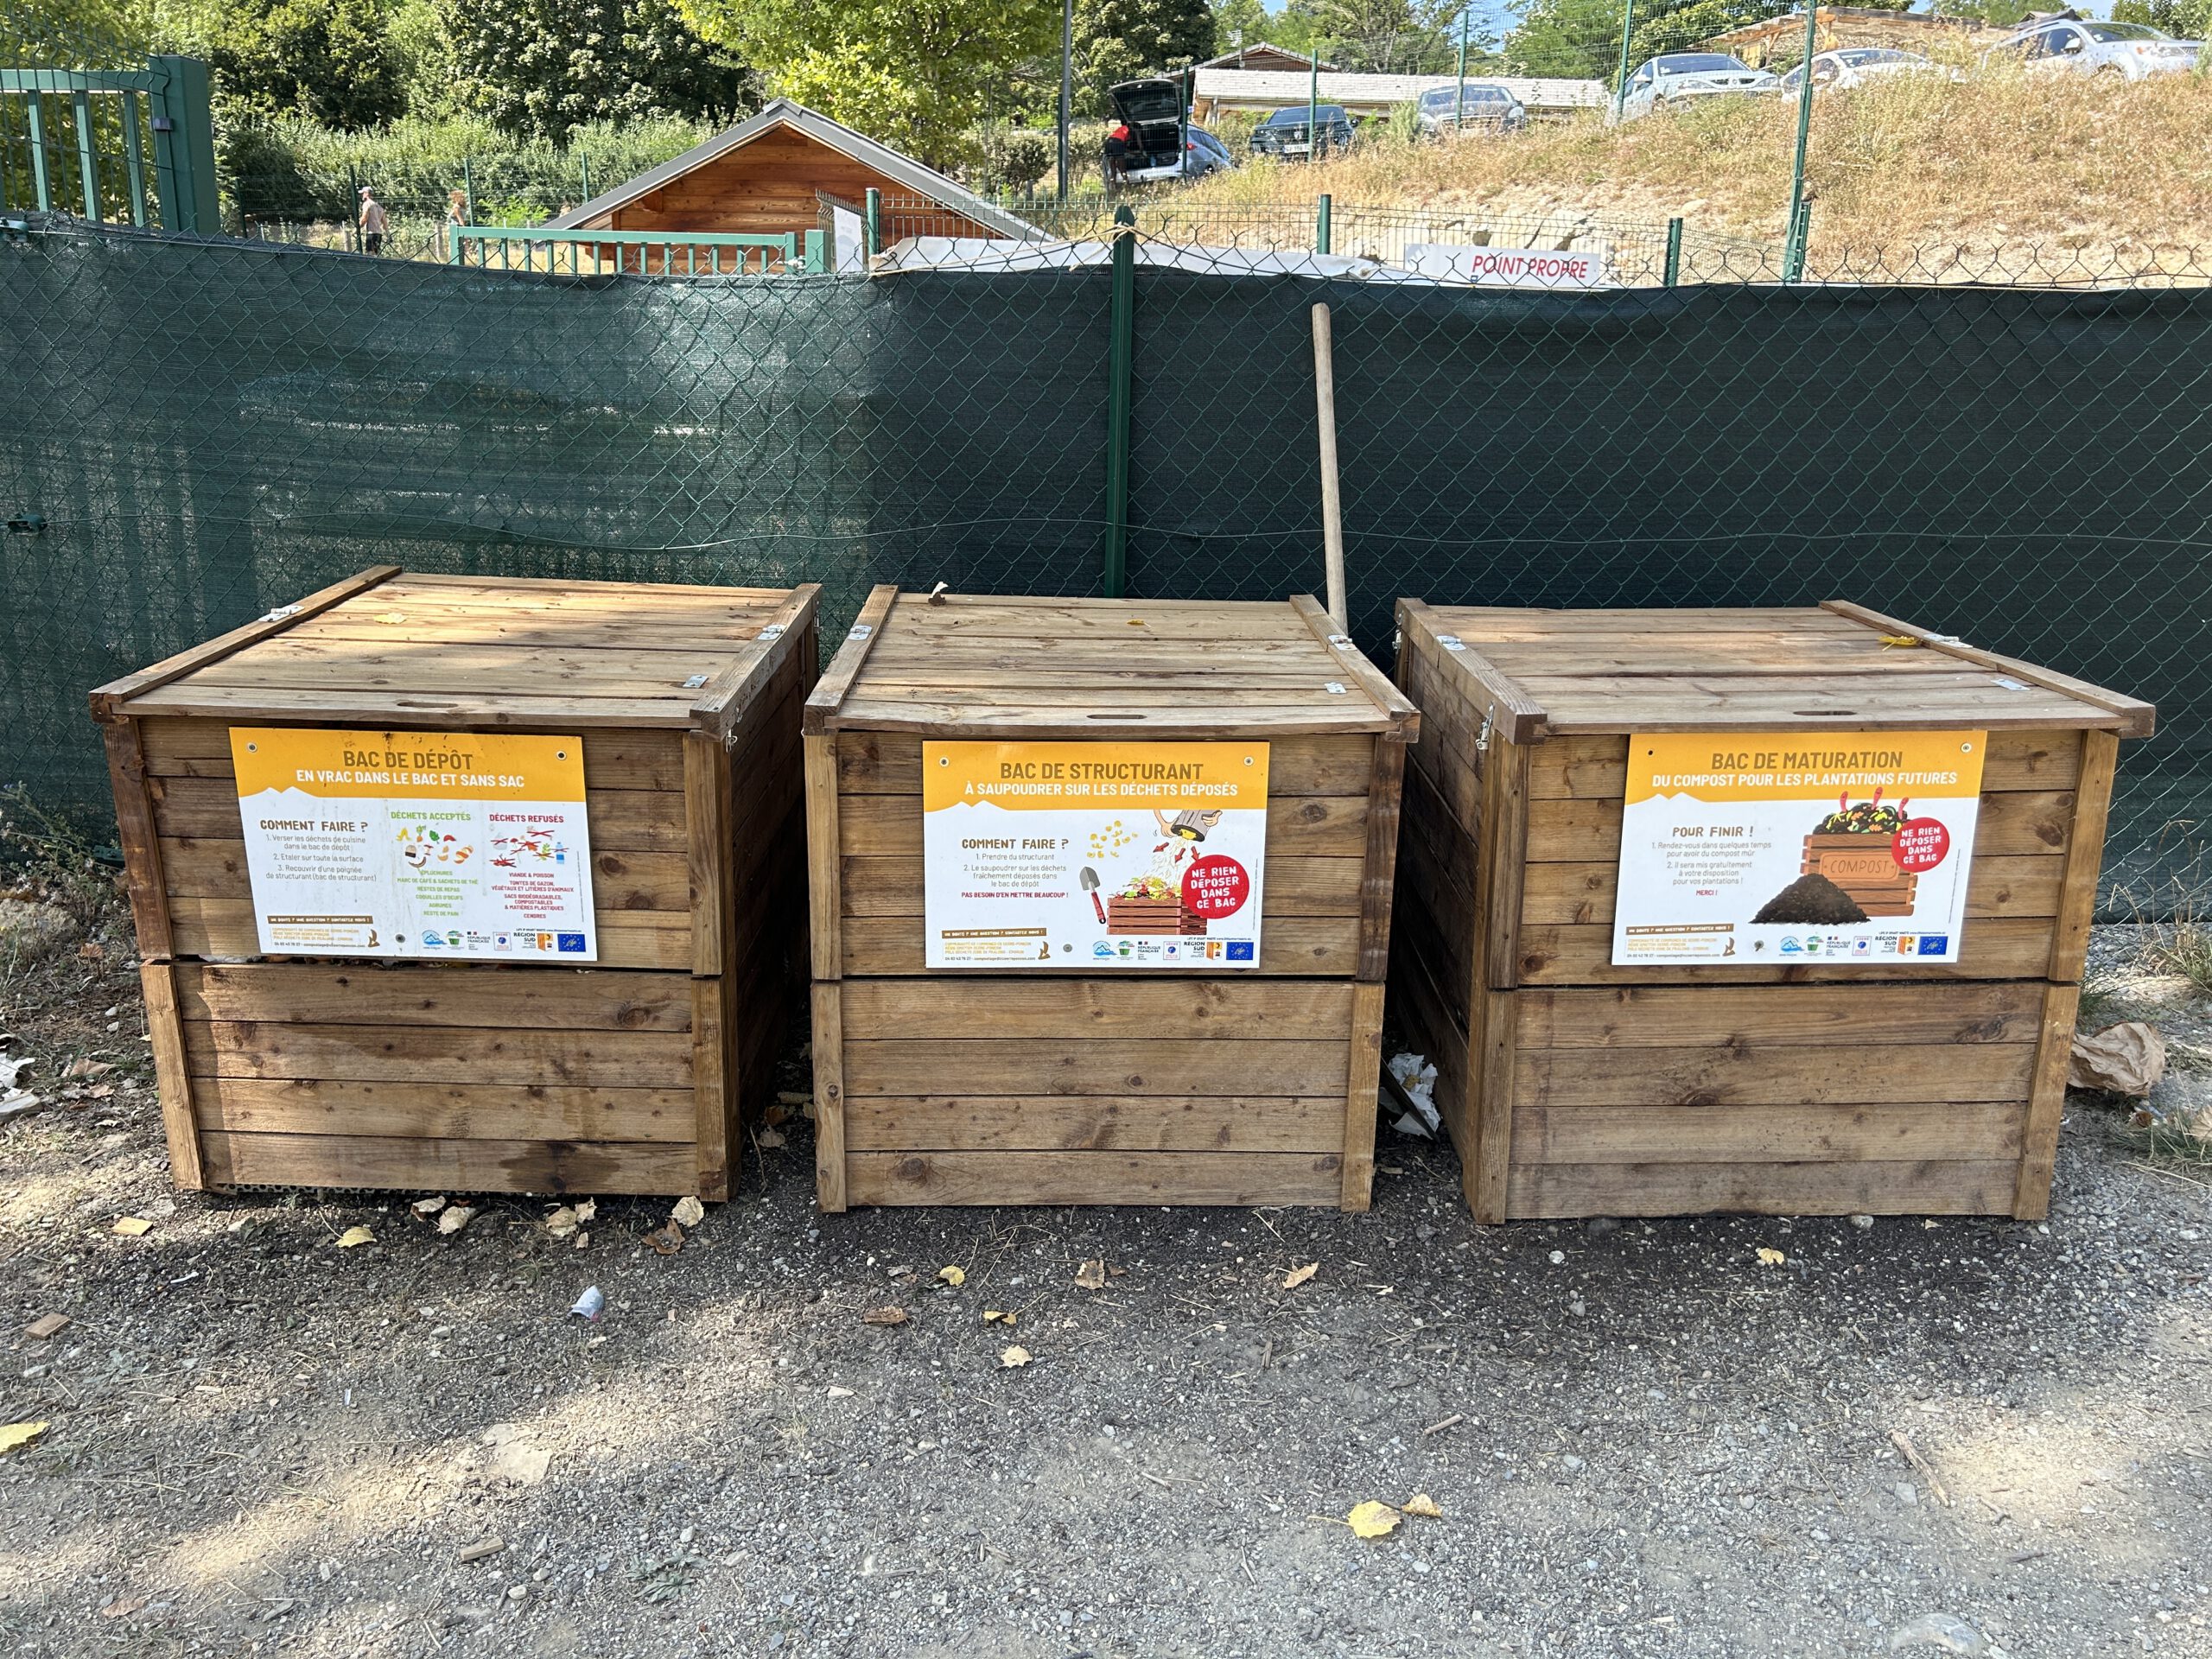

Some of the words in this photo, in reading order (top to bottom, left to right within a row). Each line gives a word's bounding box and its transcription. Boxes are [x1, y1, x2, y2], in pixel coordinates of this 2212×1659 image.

[1472, 255, 1522, 275] POINT
[1529, 258, 1588, 278] PROPRE
[344, 751, 379, 767] BAC
[386, 753, 409, 768] DE
[414, 749, 473, 770] DÉPÔT
[1712, 753, 1749, 770] BAC
[1754, 753, 1777, 769] DE
[1783, 752, 1903, 769] MATURATION
[1001, 763, 1035, 779] BAC
[1042, 763, 1065, 779] DE
[1071, 763, 1204, 779] STRUCTURANT
[296, 770, 315, 782] EN
[318, 771, 352, 783] VRAC
[356, 772, 390, 784] DANS
[393, 773, 408, 784] LE
[412, 774, 437, 785] BAC
[442, 774, 456, 785] ET
[461, 775, 496, 786] SANS
[499, 776, 524, 787] SAC
[1652, 775, 1669, 786] DU
[1674, 774, 1734, 786] COMPOST
[1738, 773, 1773, 786] POUR
[1777, 773, 1802, 786] LES
[1804, 772, 1894, 785] PLANTATIONS
[1897, 772, 1957, 785] FUTURES
[965, 780, 974, 794] À
[977, 783, 1062, 795] SAUPOUDRER
[1065, 784, 1090, 795] SUR
[1094, 784, 1116, 795] LES
[1121, 781, 1177, 796] DÉCHETS
[1181, 781, 1238, 796] DÉPOSÉS
[391, 810, 427, 820] DÉCHETS
[429, 811, 471, 820] ACCEPTÉS
[490, 813, 525, 822] DÉCHETS
[528, 814, 563, 823] REFUSÉS
[260, 820, 315, 830] COMMENT
[321, 822, 355, 831] FAIRE
[1673, 827, 1704, 837] POUR
[1710, 827, 1744, 836] FINIR
[1918, 827, 1940, 836] RIEN
[962, 839, 1016, 849] COMMENT
[1022, 839, 1055, 849] FAIRE
[1062, 839, 1069, 849] ?
[1900, 836, 1942, 847] DÉPOSER
[1908, 845, 1933, 855] DANS
[1919, 854, 1936, 862] BAC
[1192, 868, 1205, 877] NE
[1211, 867, 1236, 876] RIEN
[1831, 861, 1888, 874] COMPOST
[1191, 876, 1239, 889] DÉPOSER
[1201, 887, 1230, 898] DANS
[1197, 899, 1209, 909] CE
[1215, 898, 1236, 907] BAC
